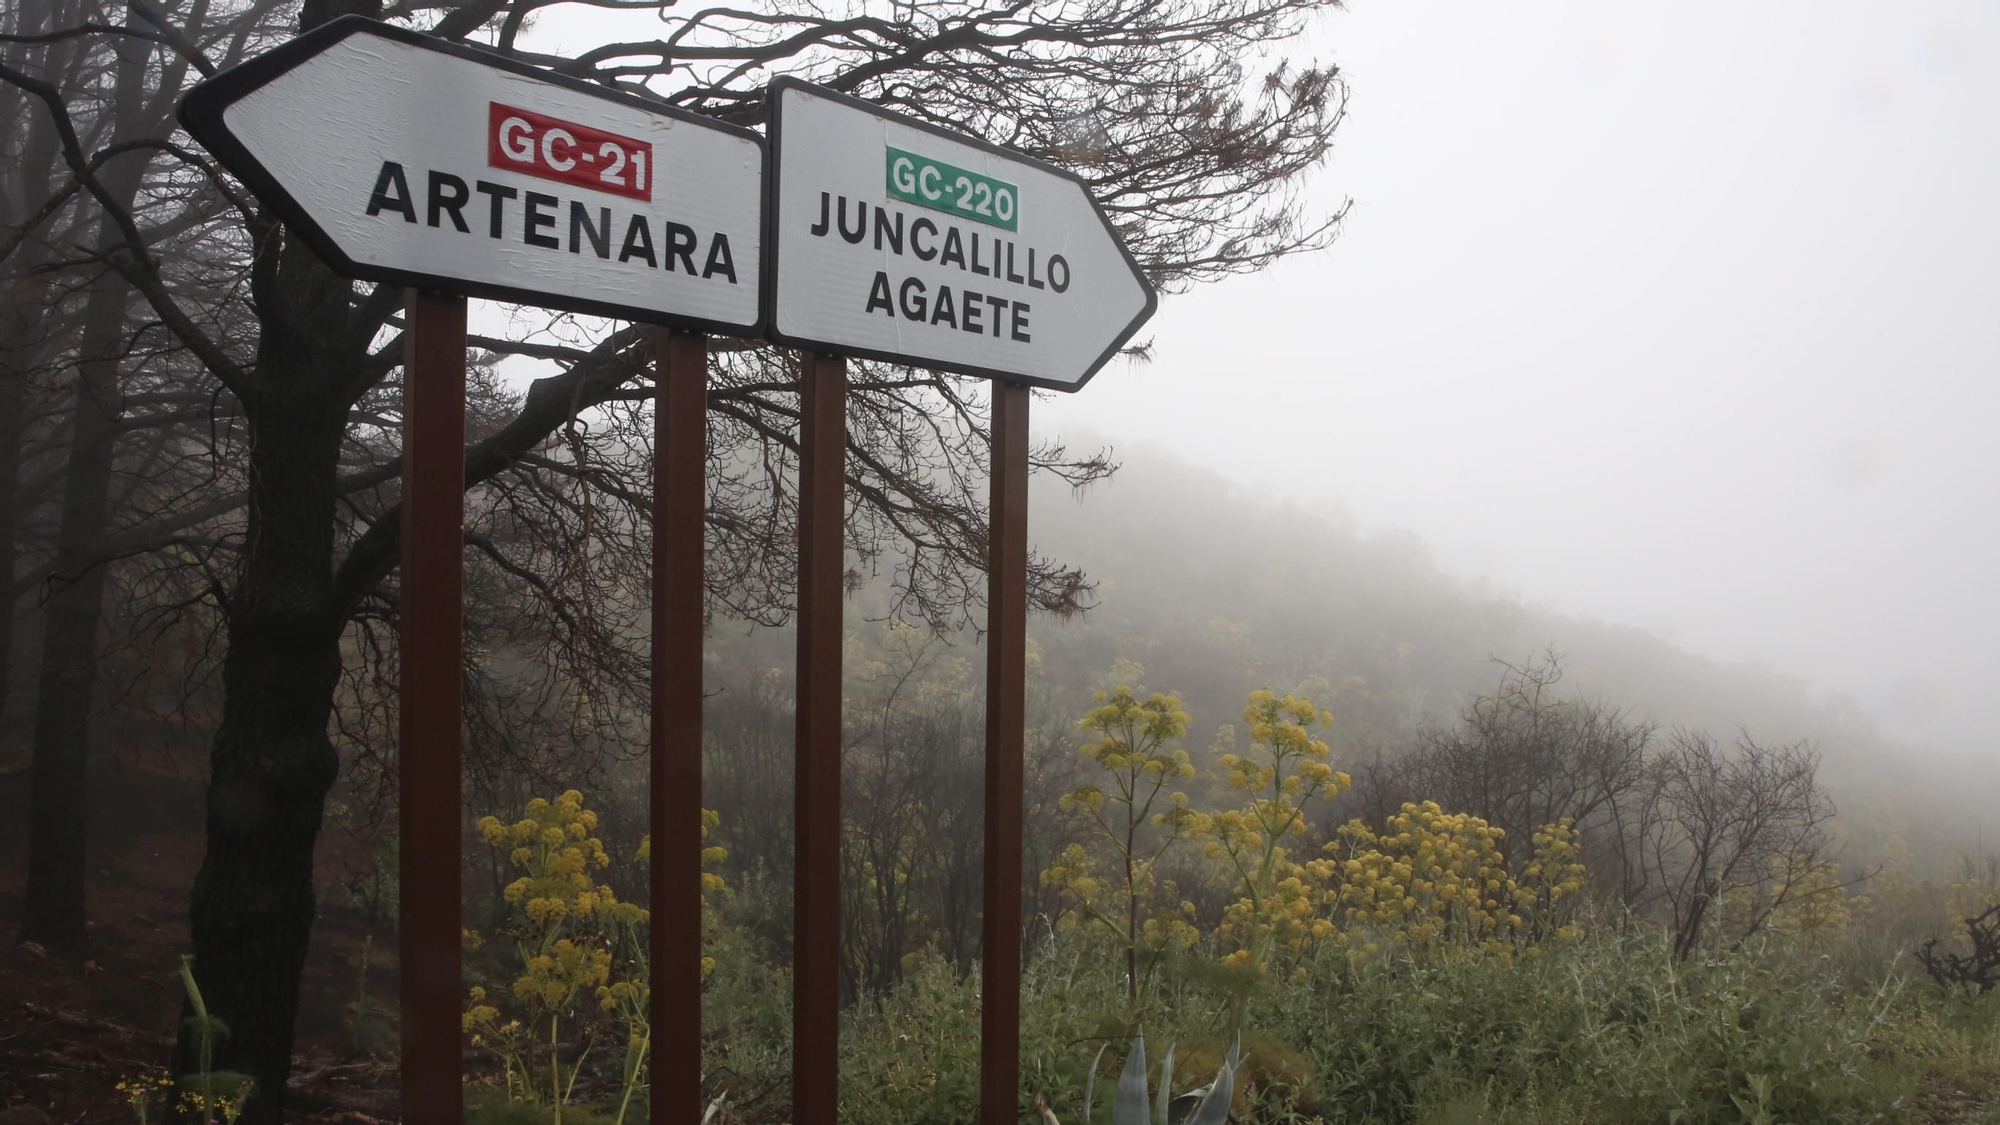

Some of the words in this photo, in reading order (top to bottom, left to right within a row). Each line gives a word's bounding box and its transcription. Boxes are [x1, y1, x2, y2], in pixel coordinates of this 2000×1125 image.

[499, 116, 646, 192] GC-21
[893, 157, 1014, 222] GC-220
[365, 160, 738, 285] ARTENARA
[810, 191, 1070, 293] JUNCALILLO
[865, 271, 1031, 343] AGAETE
